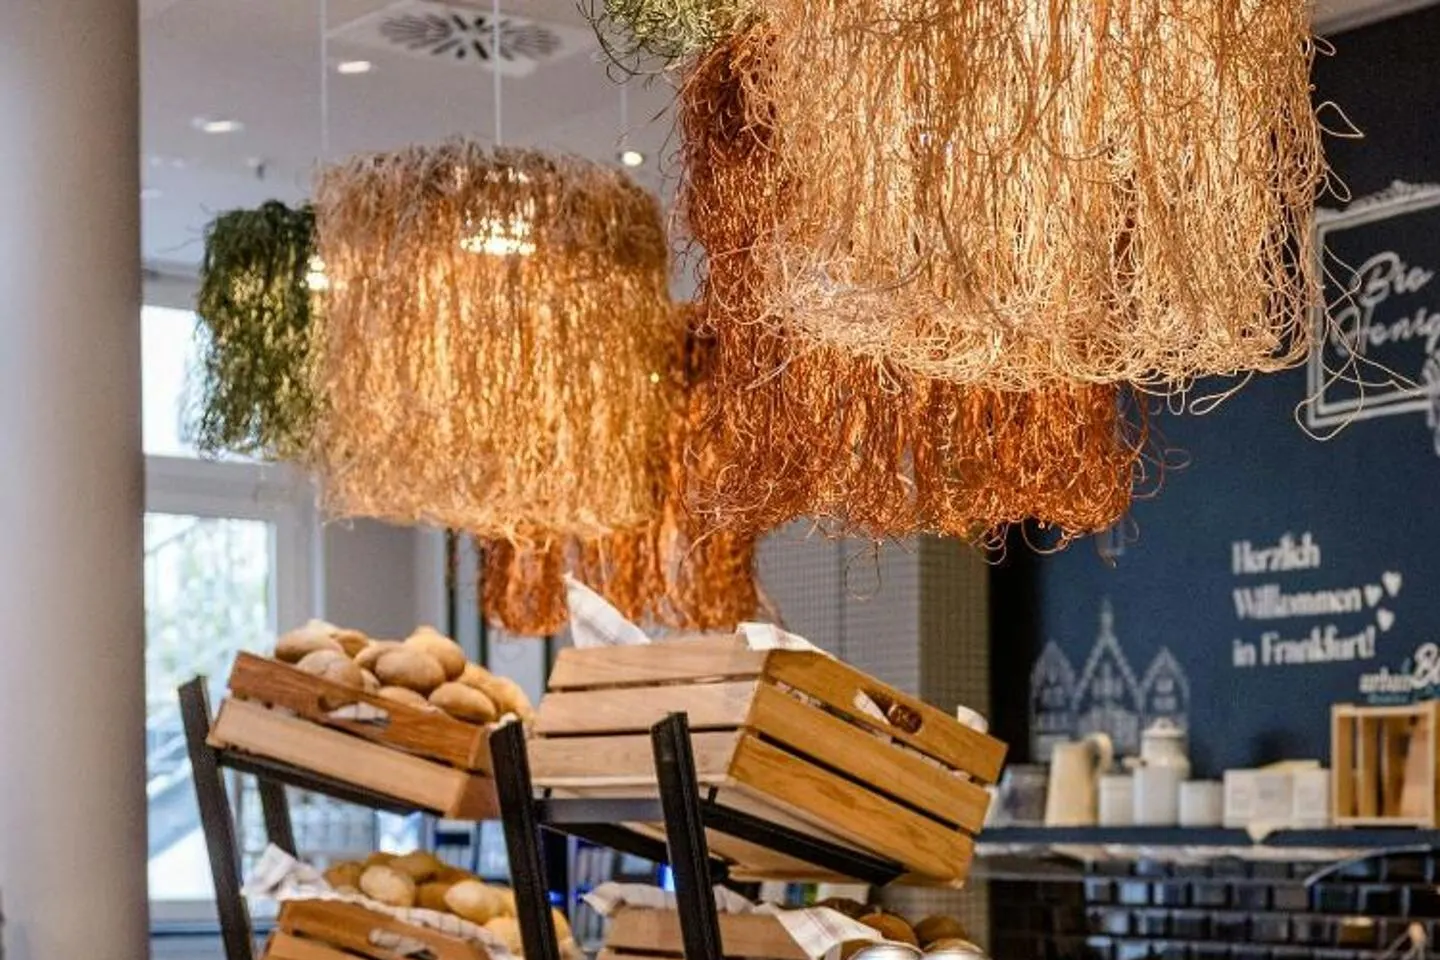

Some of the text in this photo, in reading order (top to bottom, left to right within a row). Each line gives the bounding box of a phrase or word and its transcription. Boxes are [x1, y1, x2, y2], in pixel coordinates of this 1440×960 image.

[1232, 531, 1321, 575] Herzlich
[1232, 584, 1362, 619] Willkommen
[1233, 624, 1376, 667] in Frankfurt!
